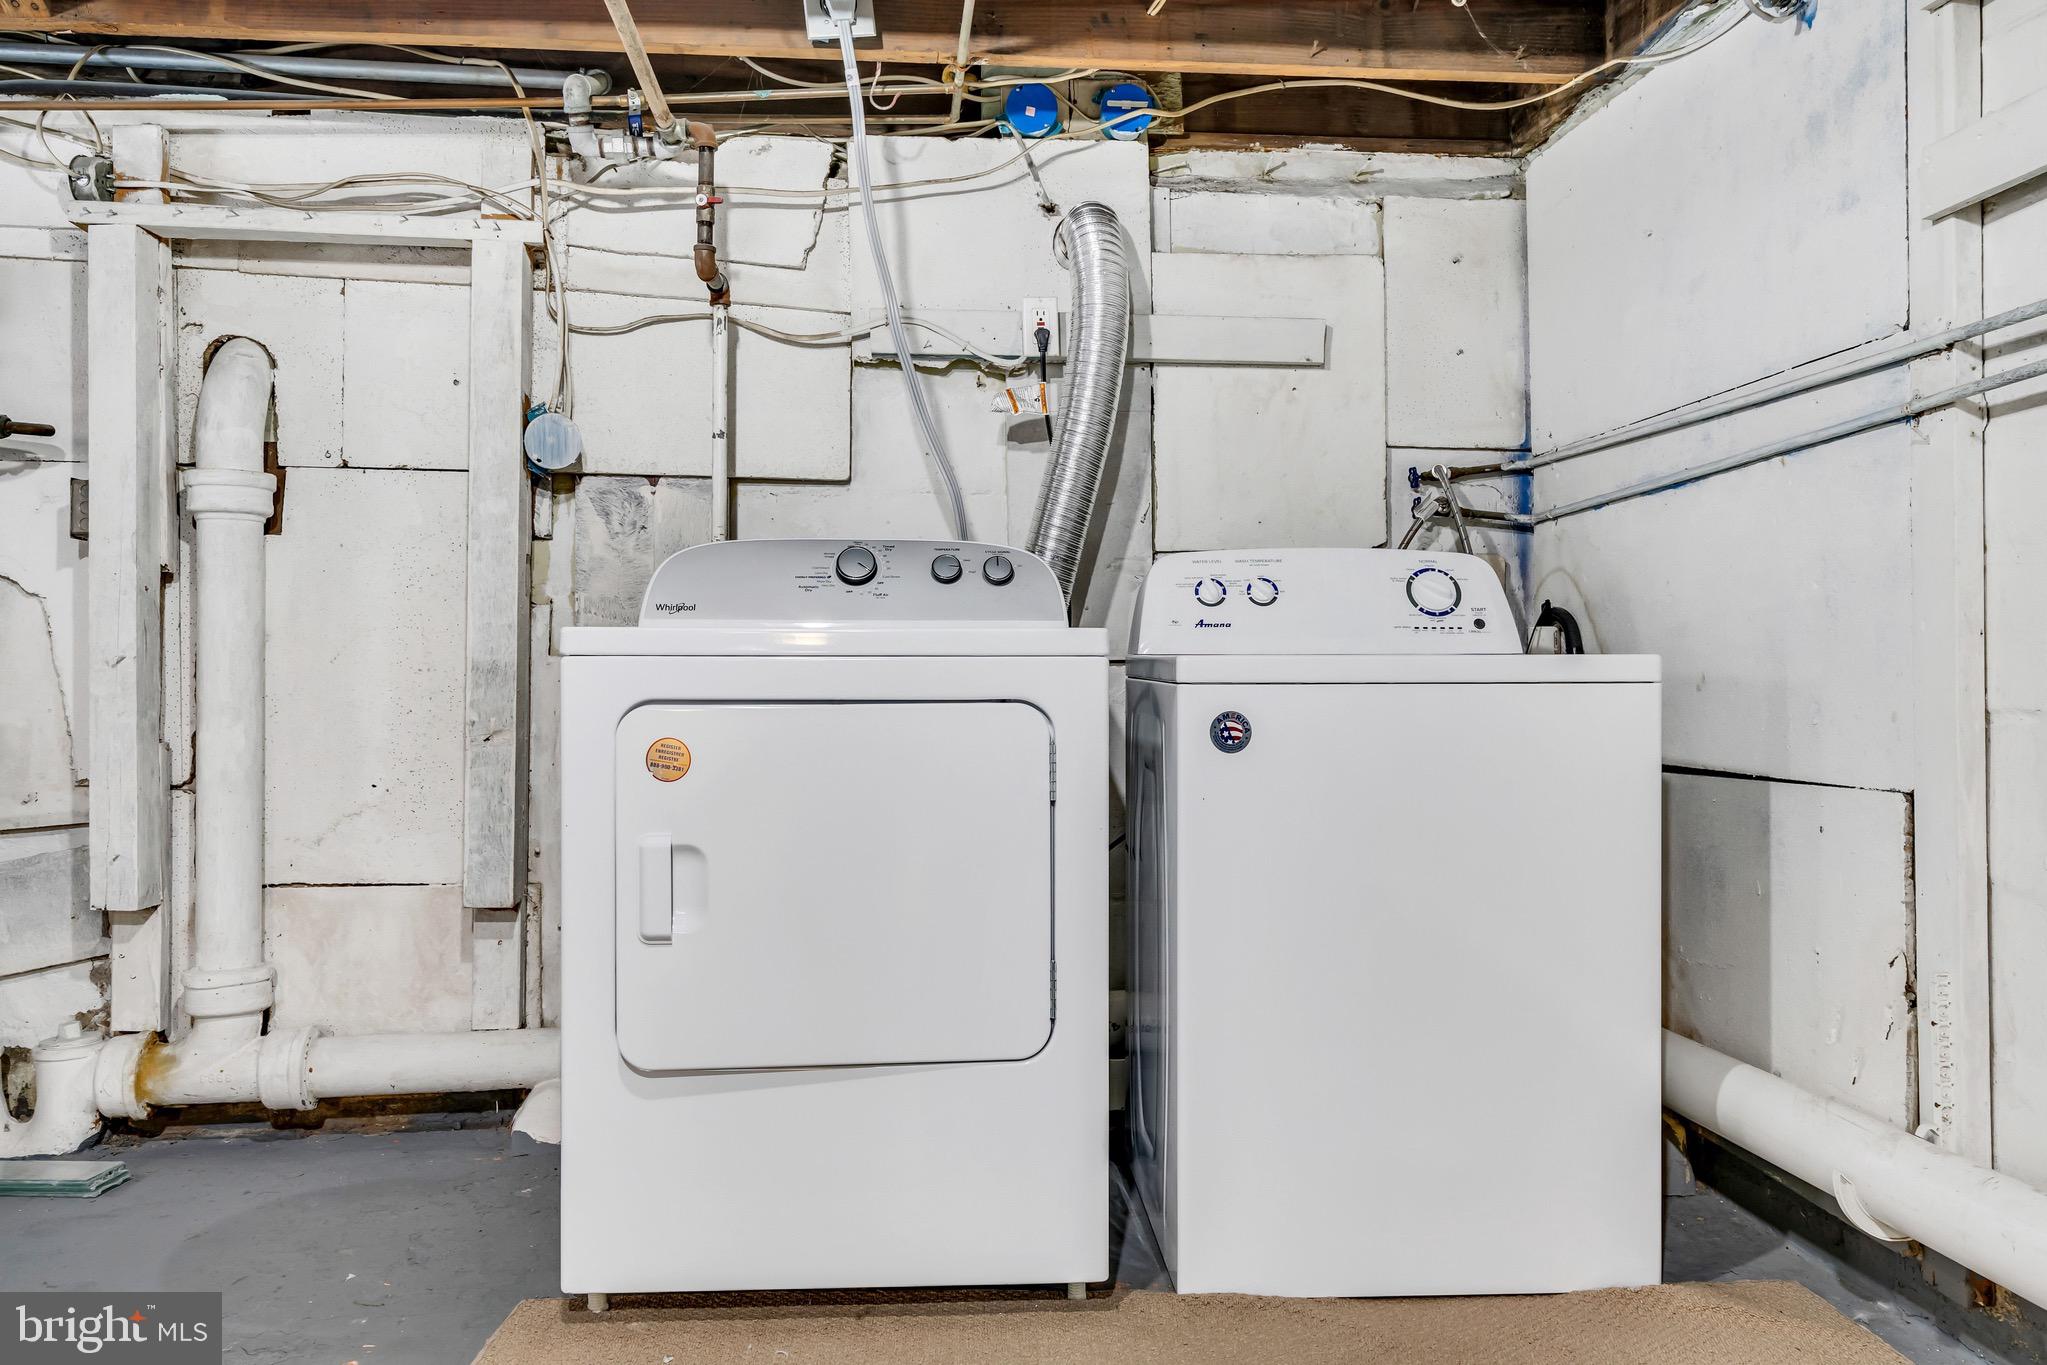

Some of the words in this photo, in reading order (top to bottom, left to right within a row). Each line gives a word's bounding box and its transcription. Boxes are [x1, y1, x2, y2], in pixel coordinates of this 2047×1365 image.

[655, 602, 696, 613] Whirlpool
[1194, 619, 1231, 628] Amana
[1216, 712, 1250, 734] AMERICA
